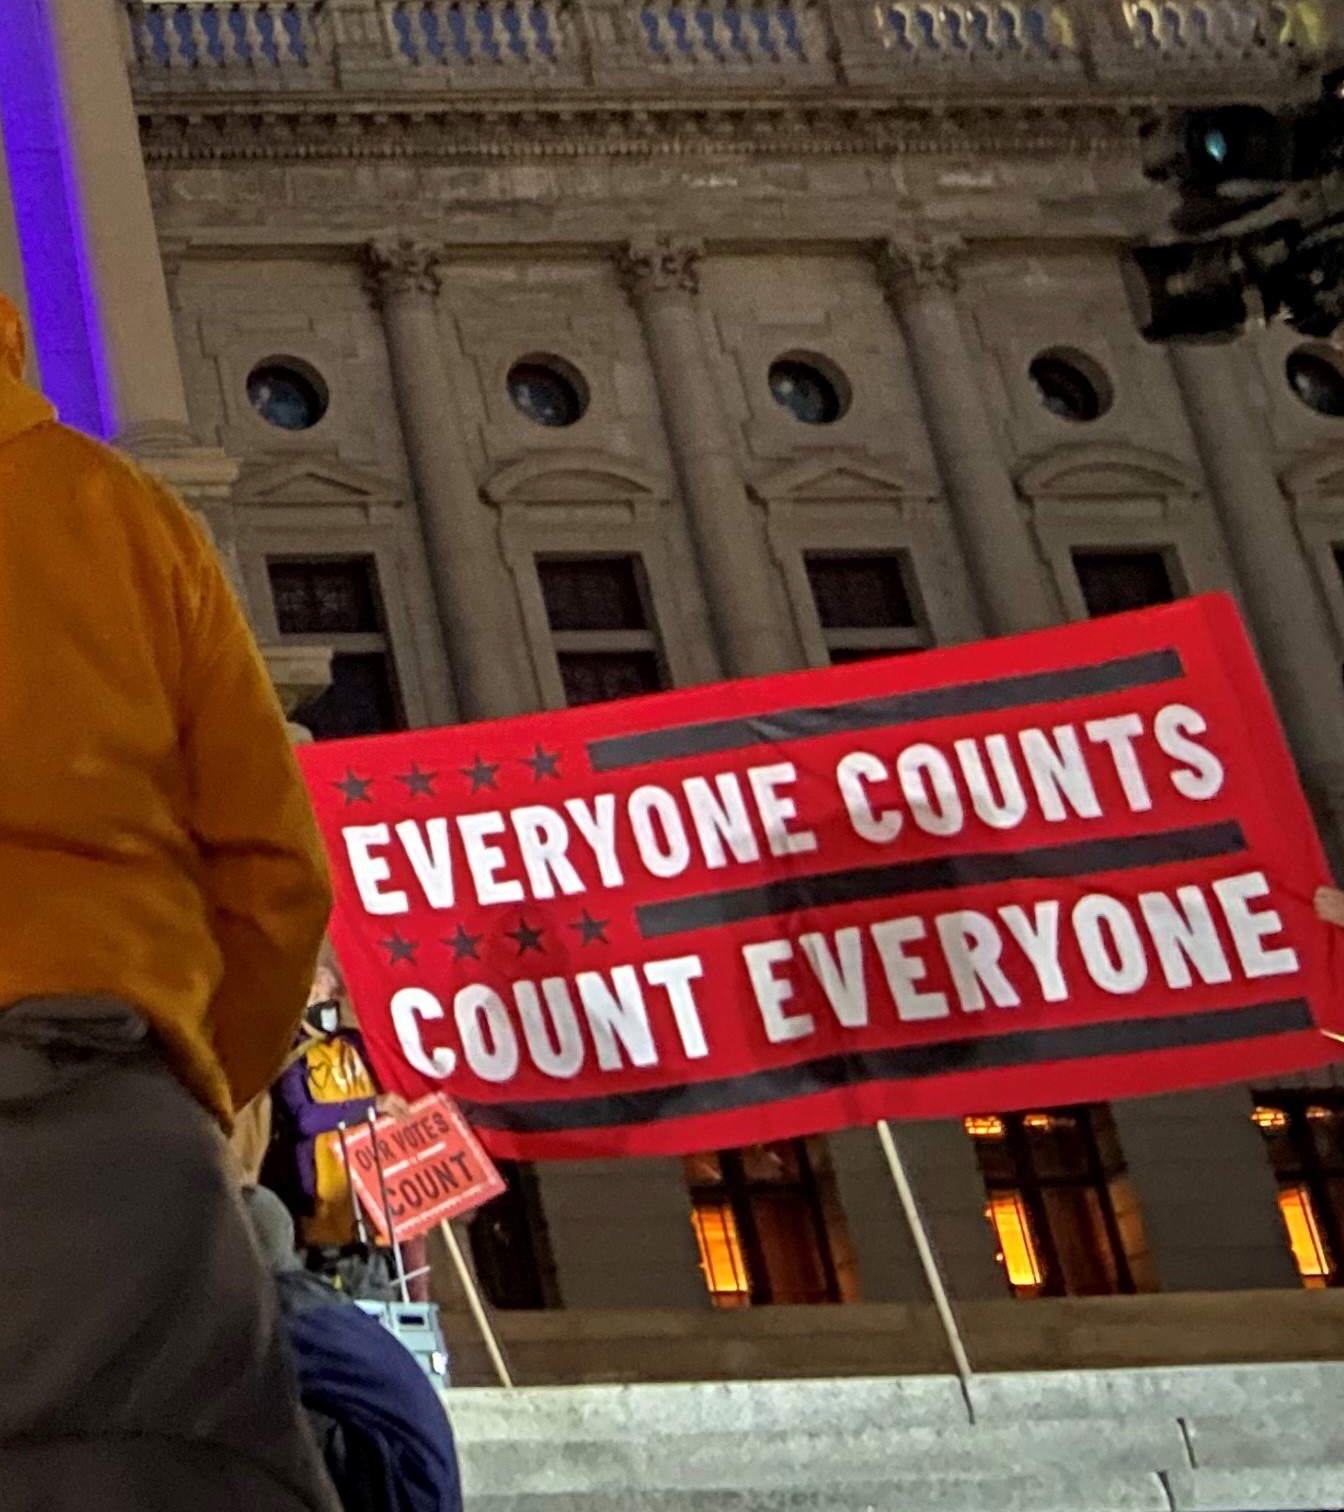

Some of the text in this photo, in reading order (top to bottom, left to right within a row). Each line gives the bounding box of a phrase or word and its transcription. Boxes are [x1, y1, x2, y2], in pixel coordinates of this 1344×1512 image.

[342, 703, 1224, 914] EVERYONE COUNTS
[390, 872, 1299, 1082] COUNT EVERYONE
[355, 1112, 450, 1171] OUR VOTES
[386, 1152, 475, 1217] COUNT
